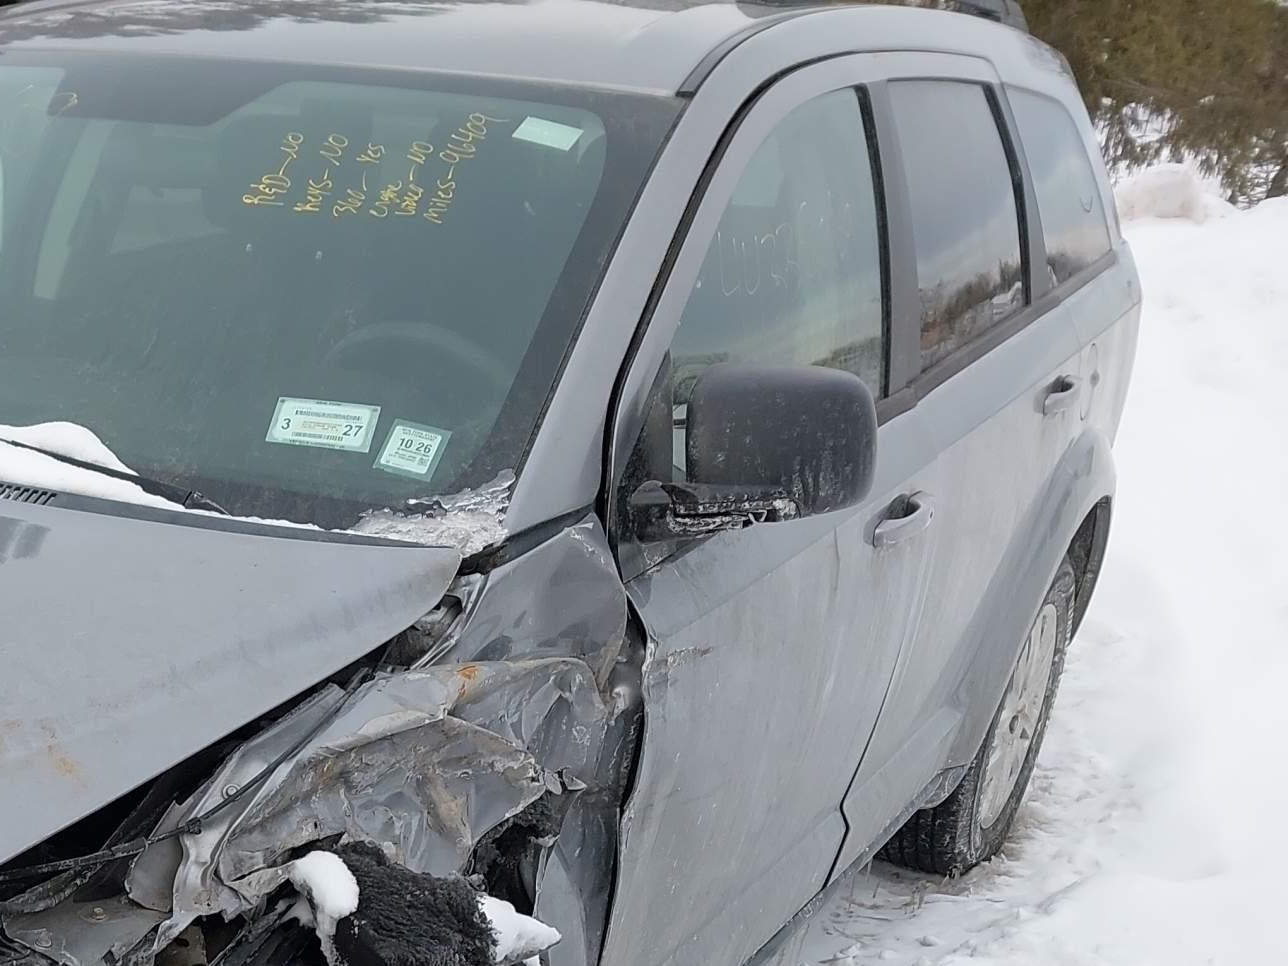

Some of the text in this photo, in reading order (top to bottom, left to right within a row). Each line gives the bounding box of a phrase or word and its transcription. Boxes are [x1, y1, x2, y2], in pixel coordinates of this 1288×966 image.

[281, 418, 292, 430] 3
[342, 424, 364, 437] 27
[399, 438, 432, 454] 10 26
